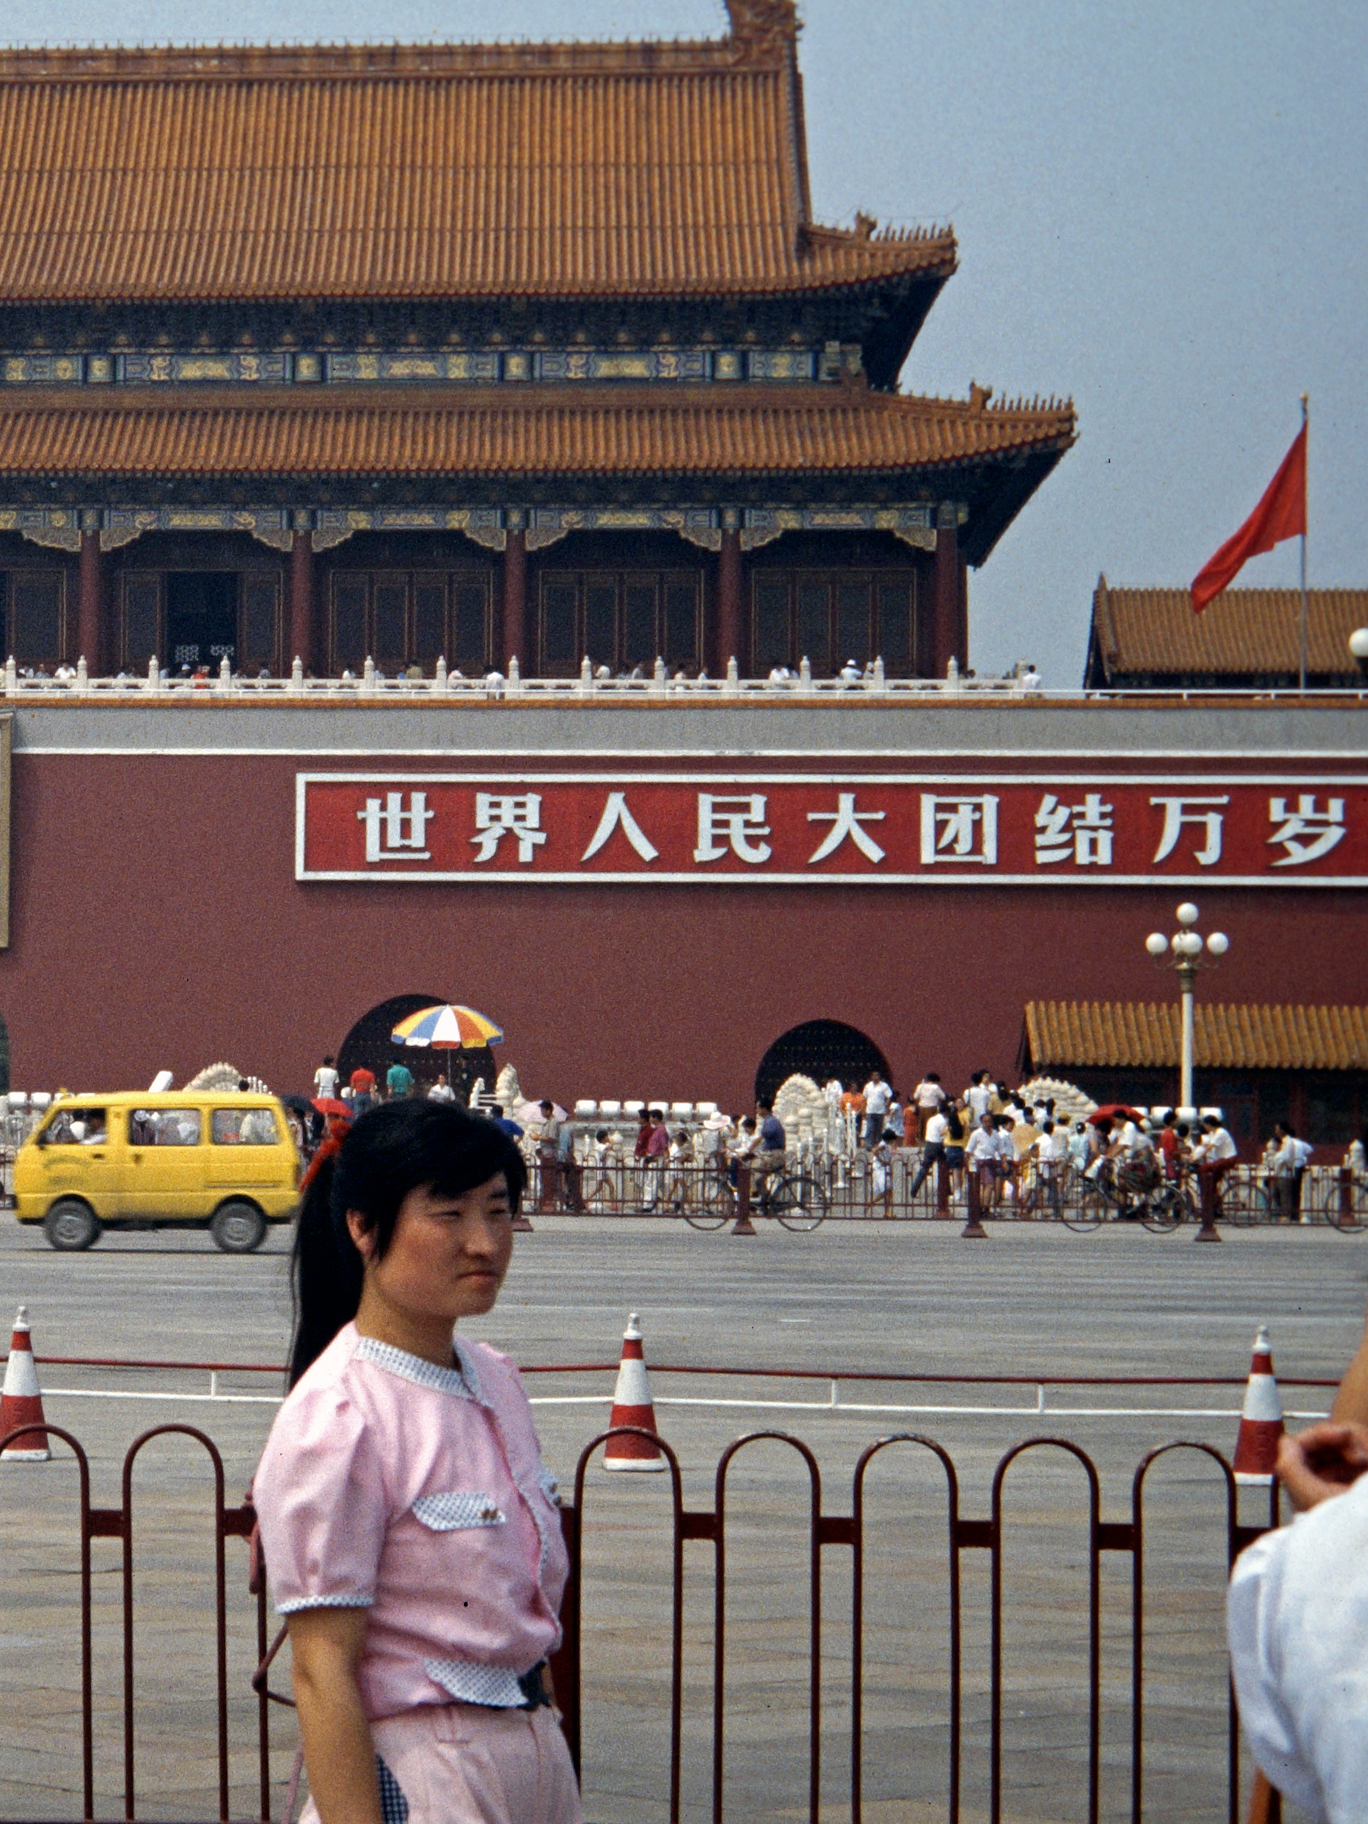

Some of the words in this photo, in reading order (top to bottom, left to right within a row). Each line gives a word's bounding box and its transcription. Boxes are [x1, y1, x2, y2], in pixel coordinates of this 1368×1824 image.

[356, 790, 1347, 867] 世界人民大团结万岁
